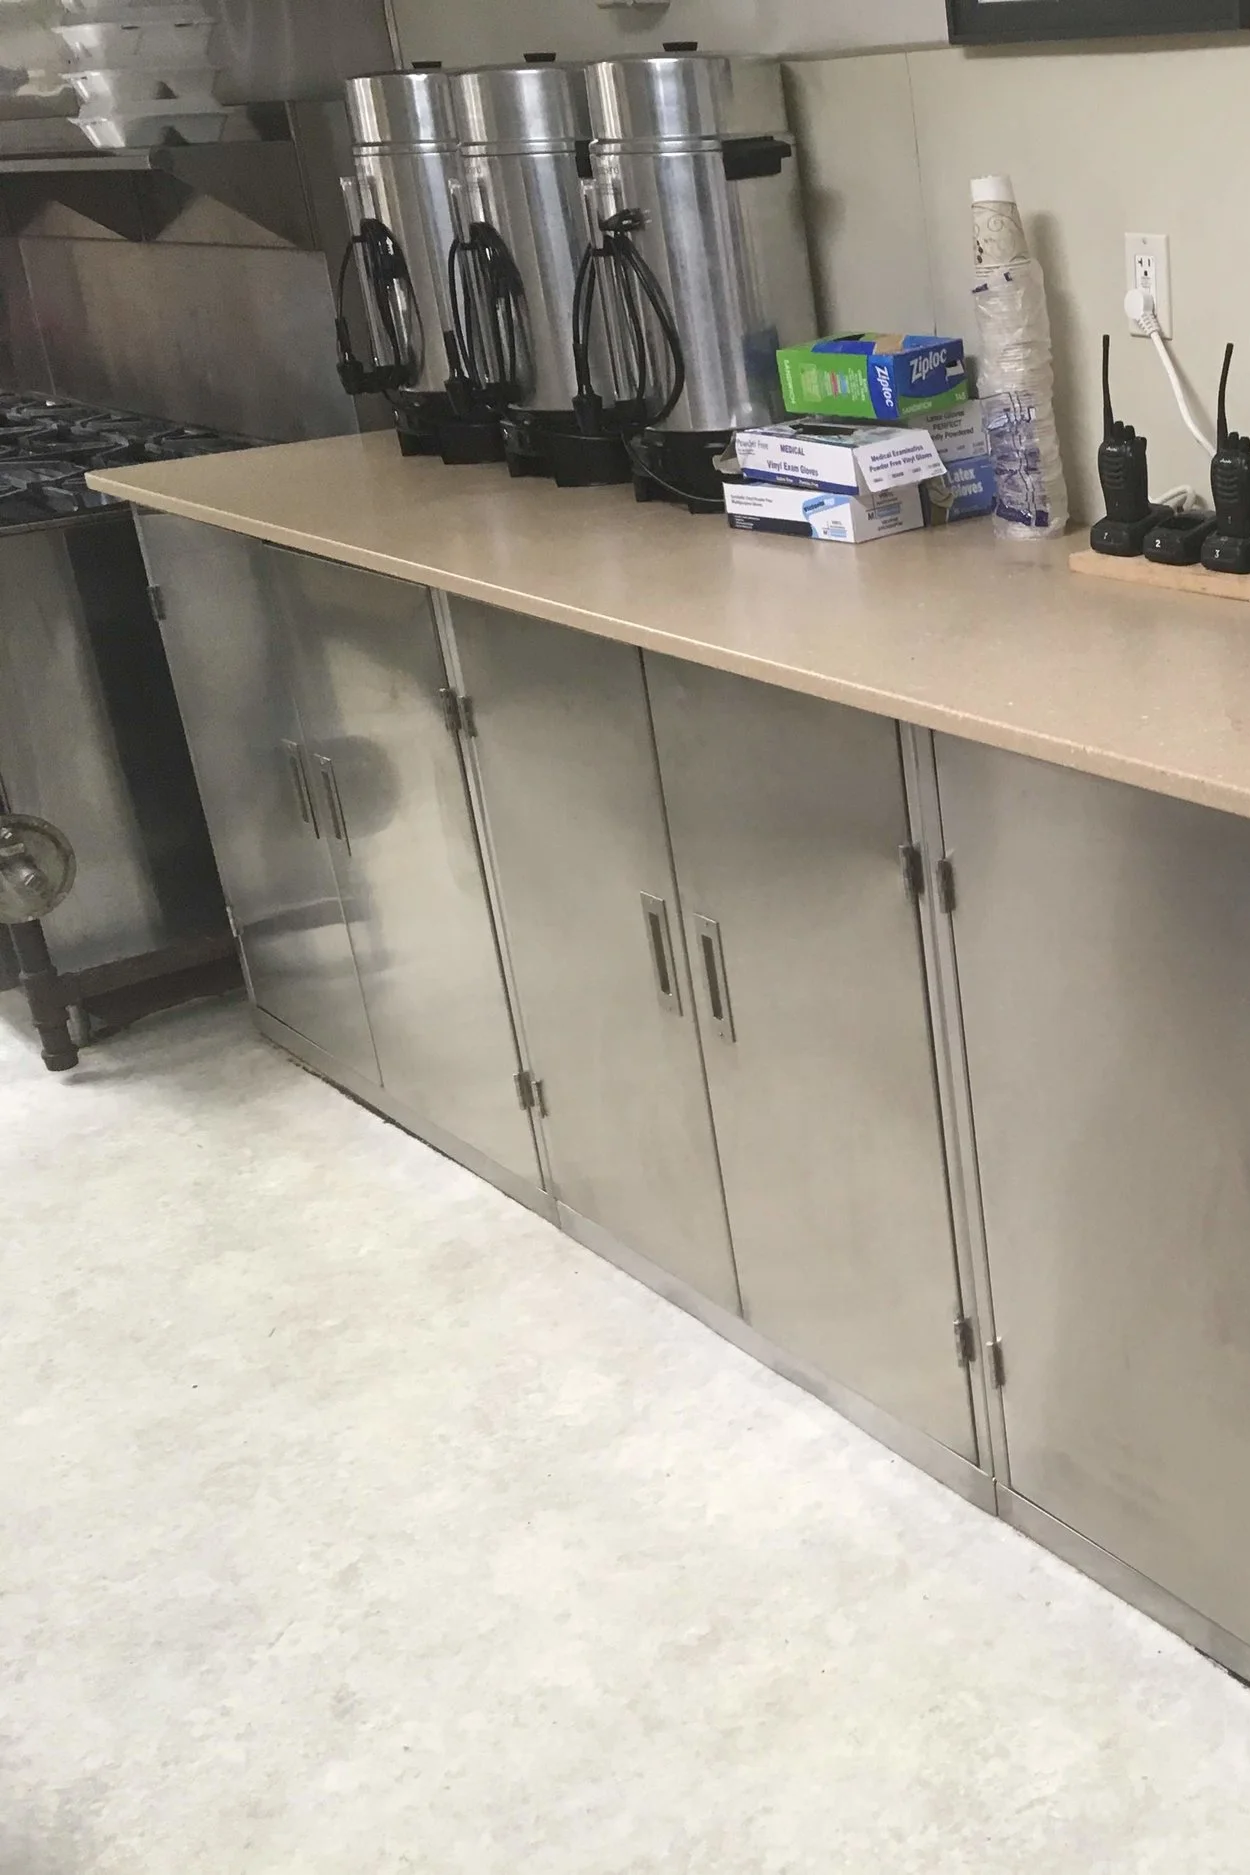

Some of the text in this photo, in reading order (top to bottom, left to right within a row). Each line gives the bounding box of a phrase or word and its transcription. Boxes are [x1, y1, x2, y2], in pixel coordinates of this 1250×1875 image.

[910, 348, 947, 384] Ziploc
[874, 365, 894, 407] Ziploc
[932, 419, 962, 431] PERFECT
[944, 427, 974, 439] Powdered
[780, 444, 805, 456] MEDICAL
[870, 451, 892, 462] Medical
[892, 444, 924, 457] Examination
[766, 460, 819, 477] Vinyl Exam Gloves
[869, 462, 889, 473] Powder
[902, 456, 915, 464] Vinyl
[947, 467, 976, 484] Latex
[951, 481, 984, 498] Gloves
[867, 512, 874, 520] M
[1155, 539, 1161, 548] 2
[1214, 549, 1220, 559] 3
